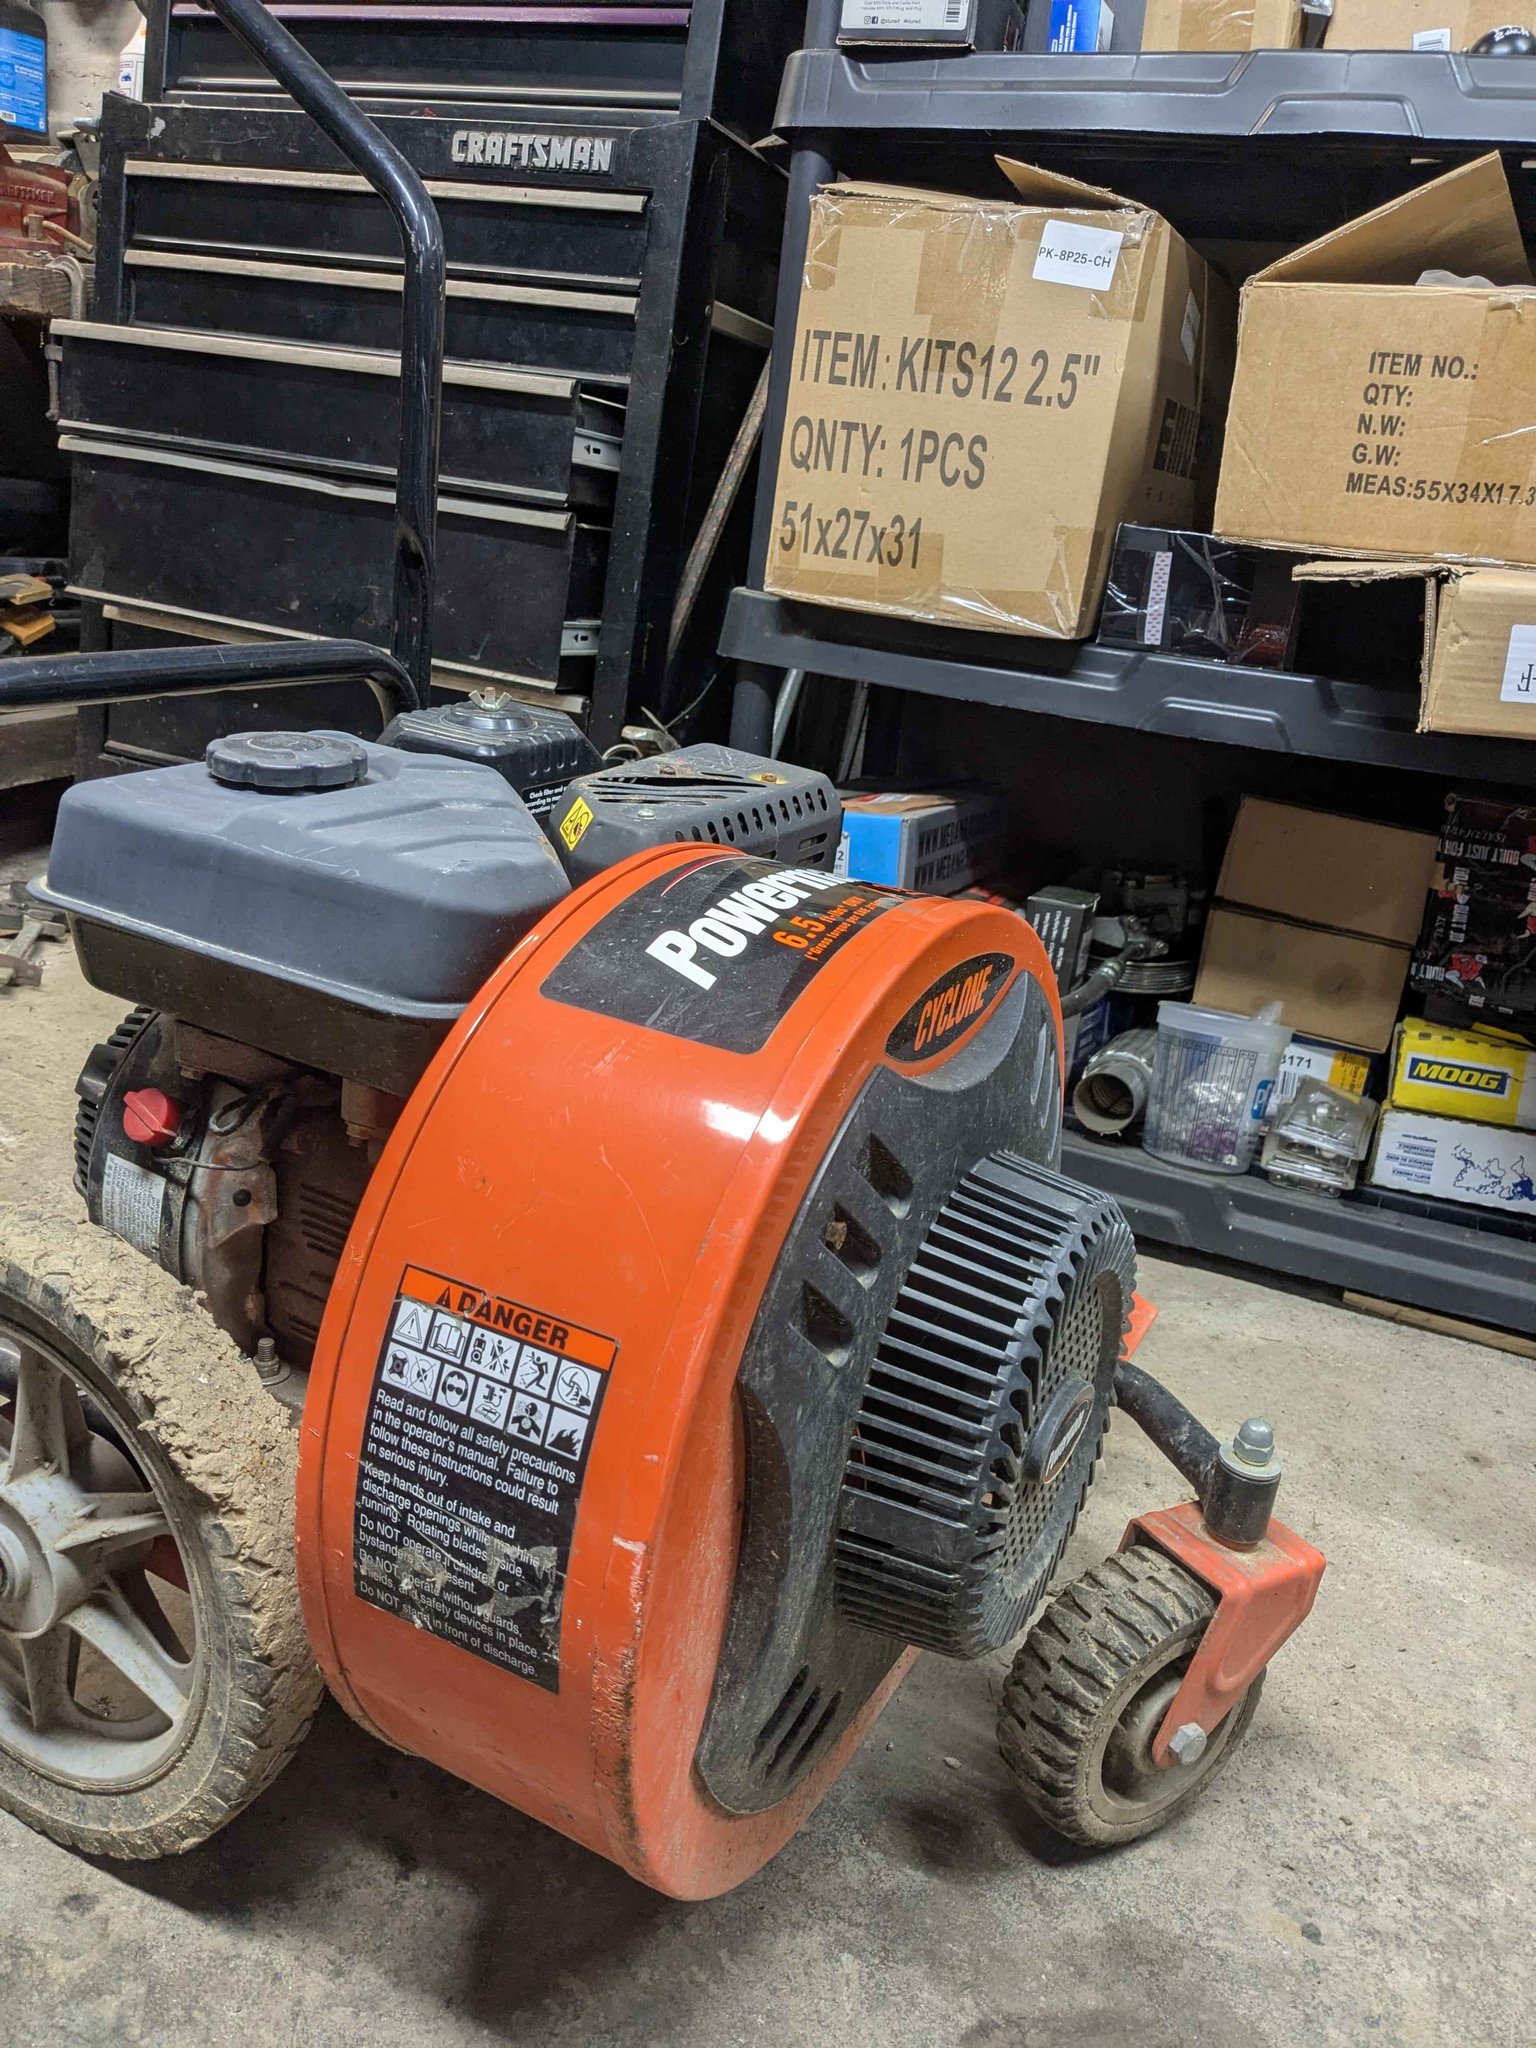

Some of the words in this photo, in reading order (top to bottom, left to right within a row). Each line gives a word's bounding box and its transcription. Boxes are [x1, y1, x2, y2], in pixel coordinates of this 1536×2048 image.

[452, 130, 615, 173] CRAFTSMAN
[0, 184, 55, 202] RAFTSMAN
[1038, 247, 1112, 268] PK-8P25-CH
[799, 329, 891, 391] ITEM:
[895, 335, 1018, 403] KITS12
[1023, 349, 1101, 409] 2.5"
[1363, 382, 1413, 407] QTY:
[1368, 351, 1423, 377] ITEM
[1431, 355, 1479, 380] NO.:
[790, 415, 886, 478] QNTY:
[900, 428, 988, 490] 1PCS
[1351, 443, 1401, 467] G.W:
[1357, 413, 1406, 437] N.W:
[779, 500, 922, 569] 51x27x31
[530, 790, 543, 799] Check
[554, 785, 563, 794] and
[1491, 847, 1520, 866] BUILT
[772, 916, 826, 949] 6.5
[914, 964, 993, 1051] CYCLONE
[1413, 1062, 1502, 1090] MOOG
[457, 1291, 569, 1351] DANGER
[367, 1439, 377, 1454] in
[379, 1446, 416, 1471] serious
[418, 1461, 449, 1487] injury.
[373, 1405, 382, 1421] in
[384, 1411, 401, 1429] the
[403, 1421, 455, 1452] operator's
[457, 1443, 500, 1472] manual.
[506, 1461, 545, 1490] Failure
[547, 1479, 559, 1496] to
[376, 1389, 404, 1412] Read
[406, 1404, 426, 1421] and
[428, 1410, 459, 1434] follow
[460, 1426, 474, 1442] all
[475, 1433, 509, 1458] safety
[510, 1448, 576, 1483] precautions
[364, 1460, 391, 1485] Keep
[392, 1474, 425, 1500] hands
[427, 1490, 444, 1508] out
[446, 1499, 458, 1513] of
[459, 1502, 492, 1528] intake
[493, 1521, 516, 1539] and
[370, 1422, 400, 1446] follow
[401, 1436, 430, 1460] these
[432, 1449, 493, 1487] instructions
[495, 1479, 526, 1500] could
[527, 1492, 559, 1516] result
[360, 1514, 374, 1530] Do
[377, 1521, 401, 1541] NOT
[403, 1536, 441, 1562] operate
[498, 1581, 510, 1593] or
[362, 1478, 411, 1510] discharge
[413, 1503, 461, 1532] openings
[464, 1525, 491, 1546] while
[494, 1538, 540, 1569] mhine
[362, 1495, 401, 1523] running.
[407, 1513, 450, 1546] Rotating
[453, 1534, 488, 1561] blades
[360, 1529, 413, 1563] bystanders
[438, 1566, 477, 1594] esent.
[360, 1547, 373, 1564] Do
[376, 1555, 399, 1577] NOT
[443, 1591, 481, 1616] without
[483, 1612, 522, 1637] guards,
[360, 1565, 396, 1591] hields,
[420, 1594, 451, 1618] safety
[453, 1609, 494, 1637] devices
[496, 1628, 506, 1643] in
[508, 1636, 540, 1659] place.
[360, 1581, 374, 1596] Do
[377, 1588, 400, 1609] NOT
[402, 1603, 430, 1621] stand
[432, 1618, 441, 1628] in
[444, 1623, 468, 1642] front
[470, 1637, 480, 1649] of
[483, 1643, 538, 1677] discharge.
